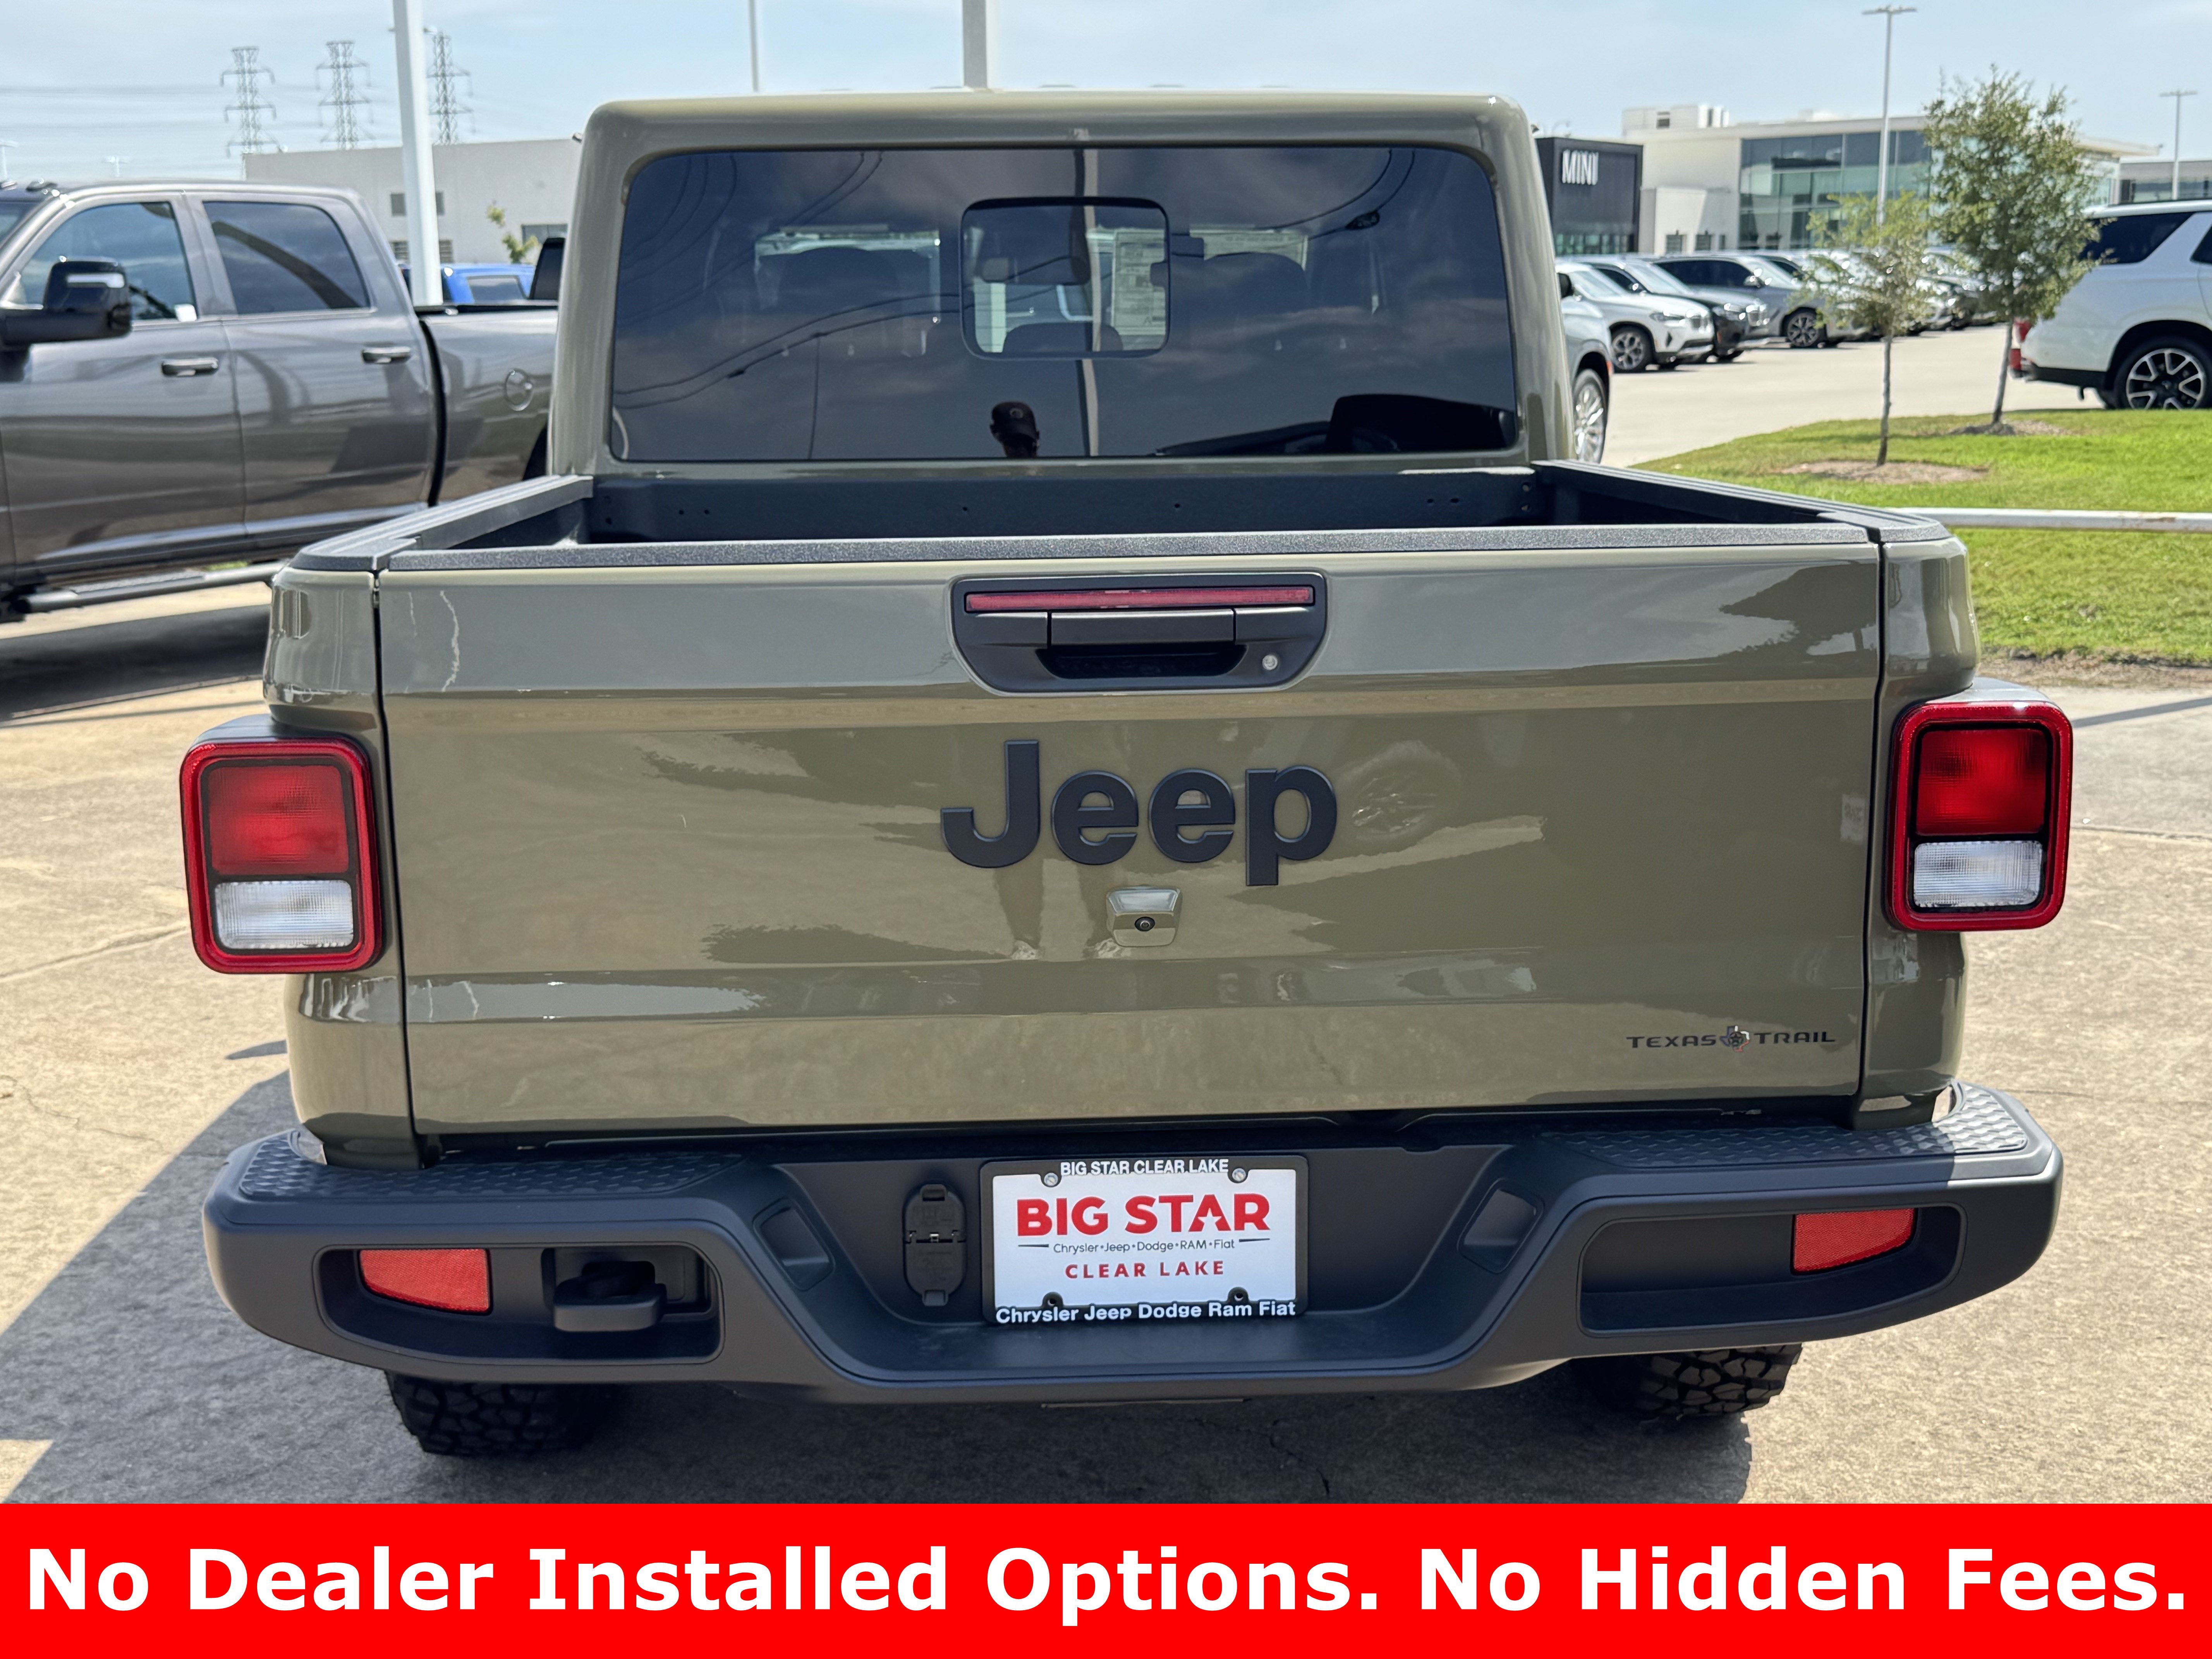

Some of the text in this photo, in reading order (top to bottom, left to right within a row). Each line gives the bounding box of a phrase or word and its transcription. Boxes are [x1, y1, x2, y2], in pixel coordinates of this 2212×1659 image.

[1562, 149, 1599, 185] MINI
[940, 739, 1337, 886] Jeep
[1626, 1031, 1835, 1048] TEXAS TRAIL
[1060, 1159, 1229, 1176] BIG STAR CLEAR LAKE
[1017, 1194, 1271, 1237] BIG STAR
[1053, 1239, 1235, 1255] Chrysler Jeep Dodge RAM Fiat
[1065, 1261, 1224, 1279] CLEAR LAKE
[995, 1301, 1296, 1324] Chrysler Jeep Dodge Ram Fiat
